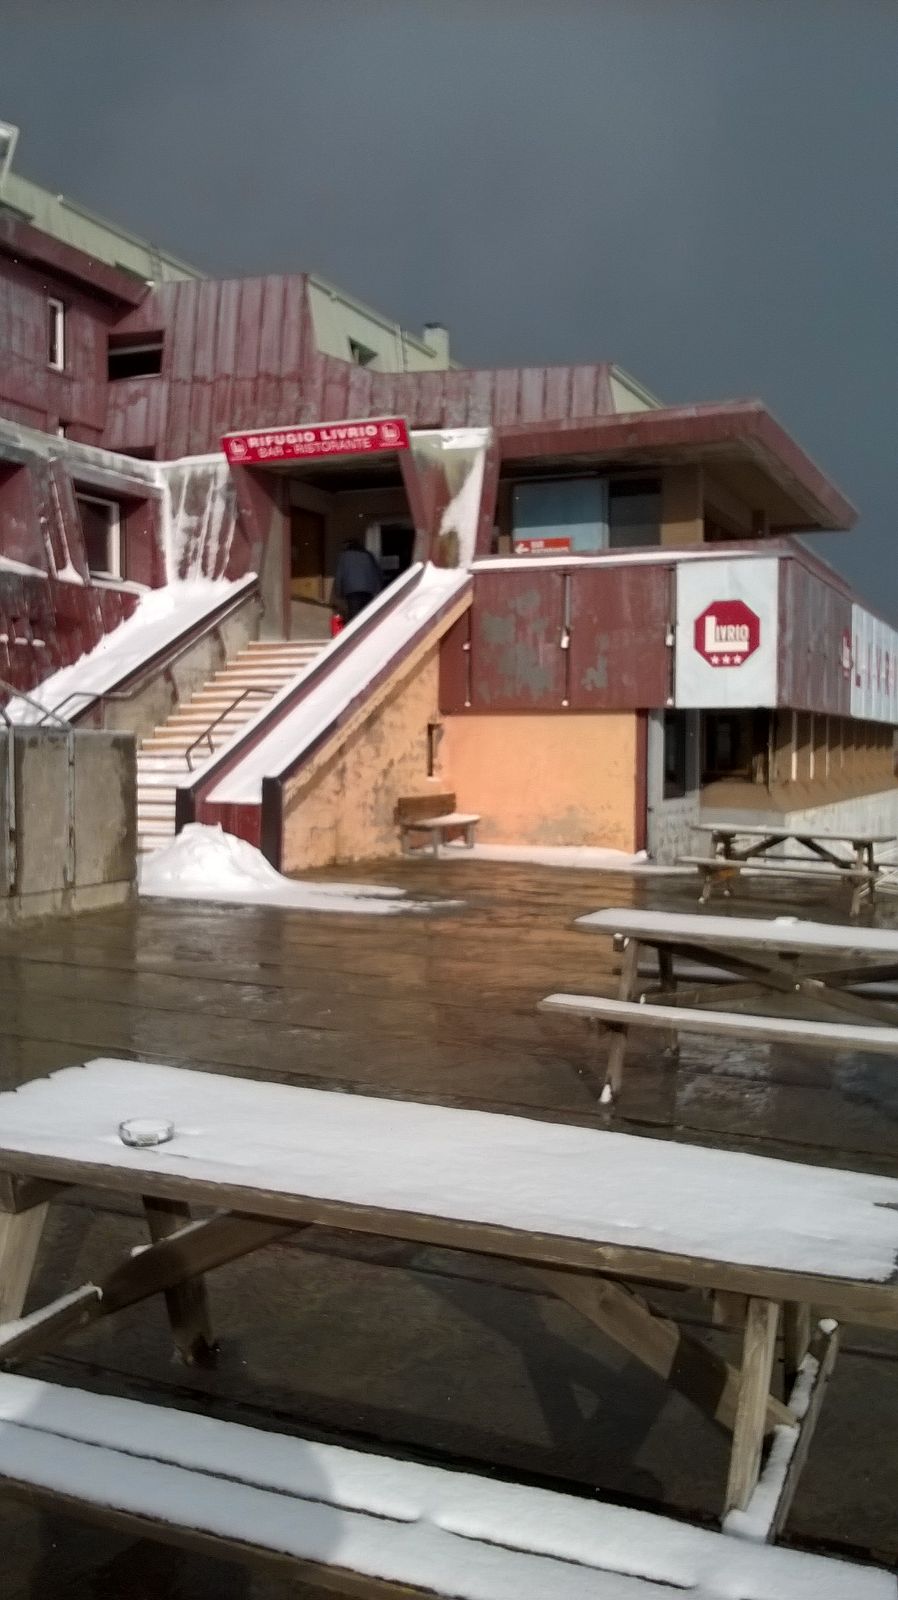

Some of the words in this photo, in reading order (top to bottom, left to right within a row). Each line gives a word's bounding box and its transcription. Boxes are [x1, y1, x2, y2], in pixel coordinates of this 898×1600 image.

[247, 431, 316, 448] RIFUGIO
[320, 425, 378, 441] LIVRIO
[257, 447, 284, 459] BAR
[294, 438, 372, 454] RISTORANTE
